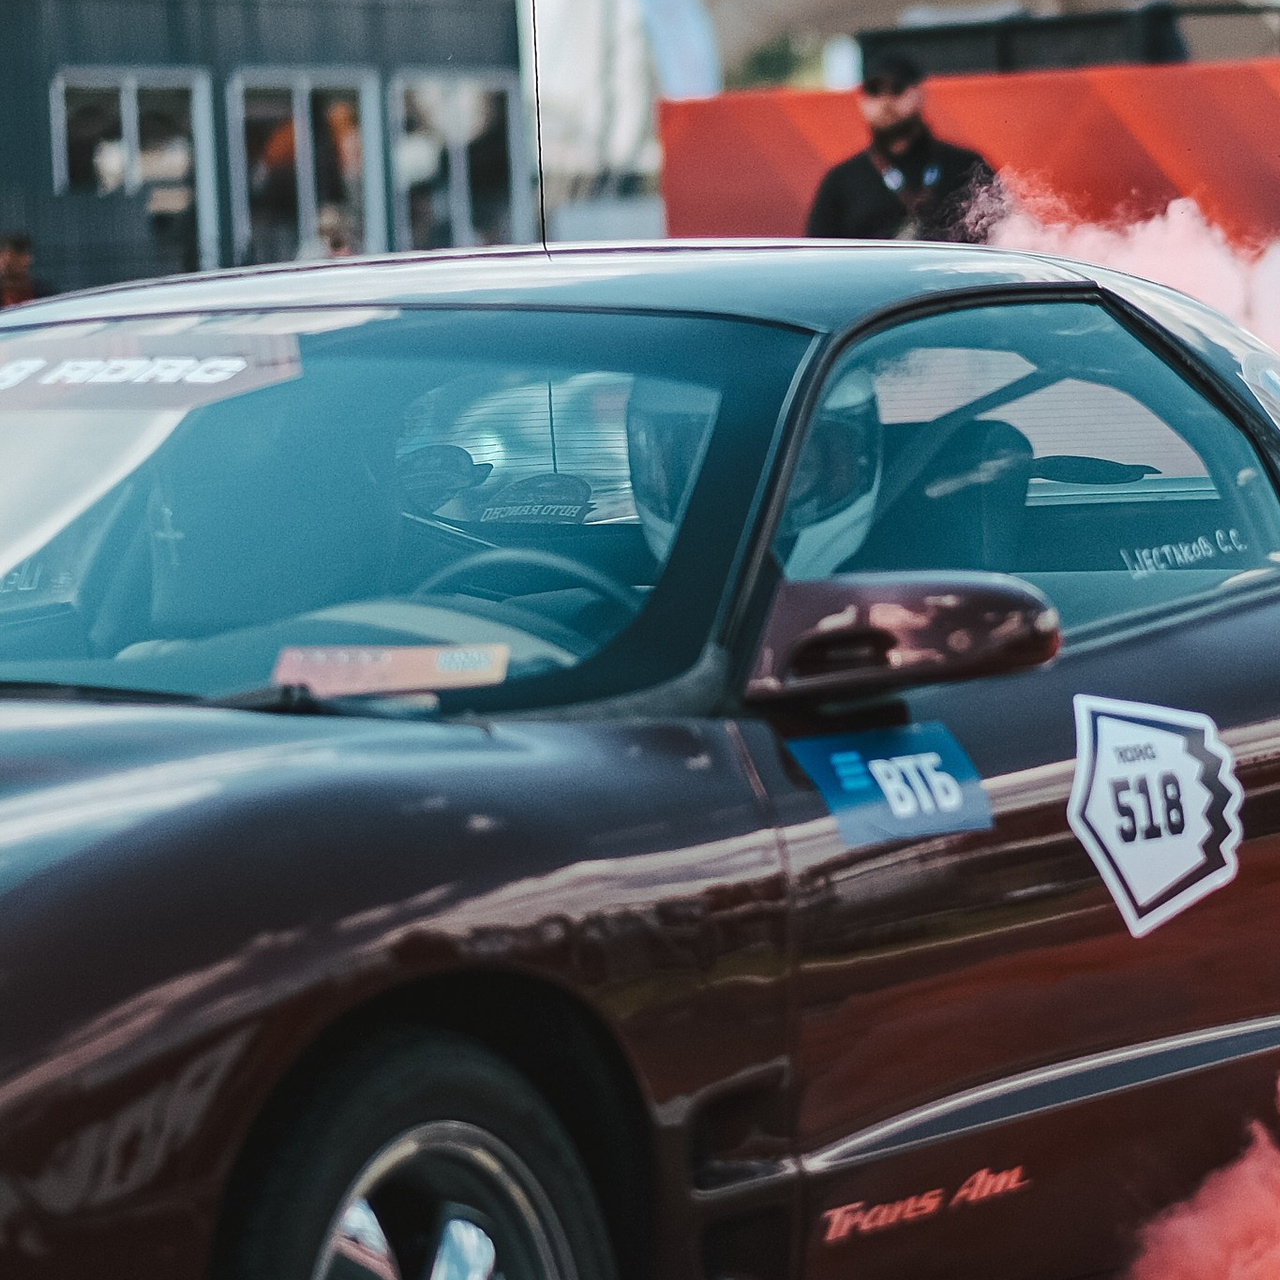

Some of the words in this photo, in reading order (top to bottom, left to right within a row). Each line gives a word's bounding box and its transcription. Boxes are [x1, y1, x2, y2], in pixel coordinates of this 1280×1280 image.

[868, 751, 963, 819] ВТБ
[1110, 771, 1185, 843] 518
[821, 1188, 945, 1241] Trans
